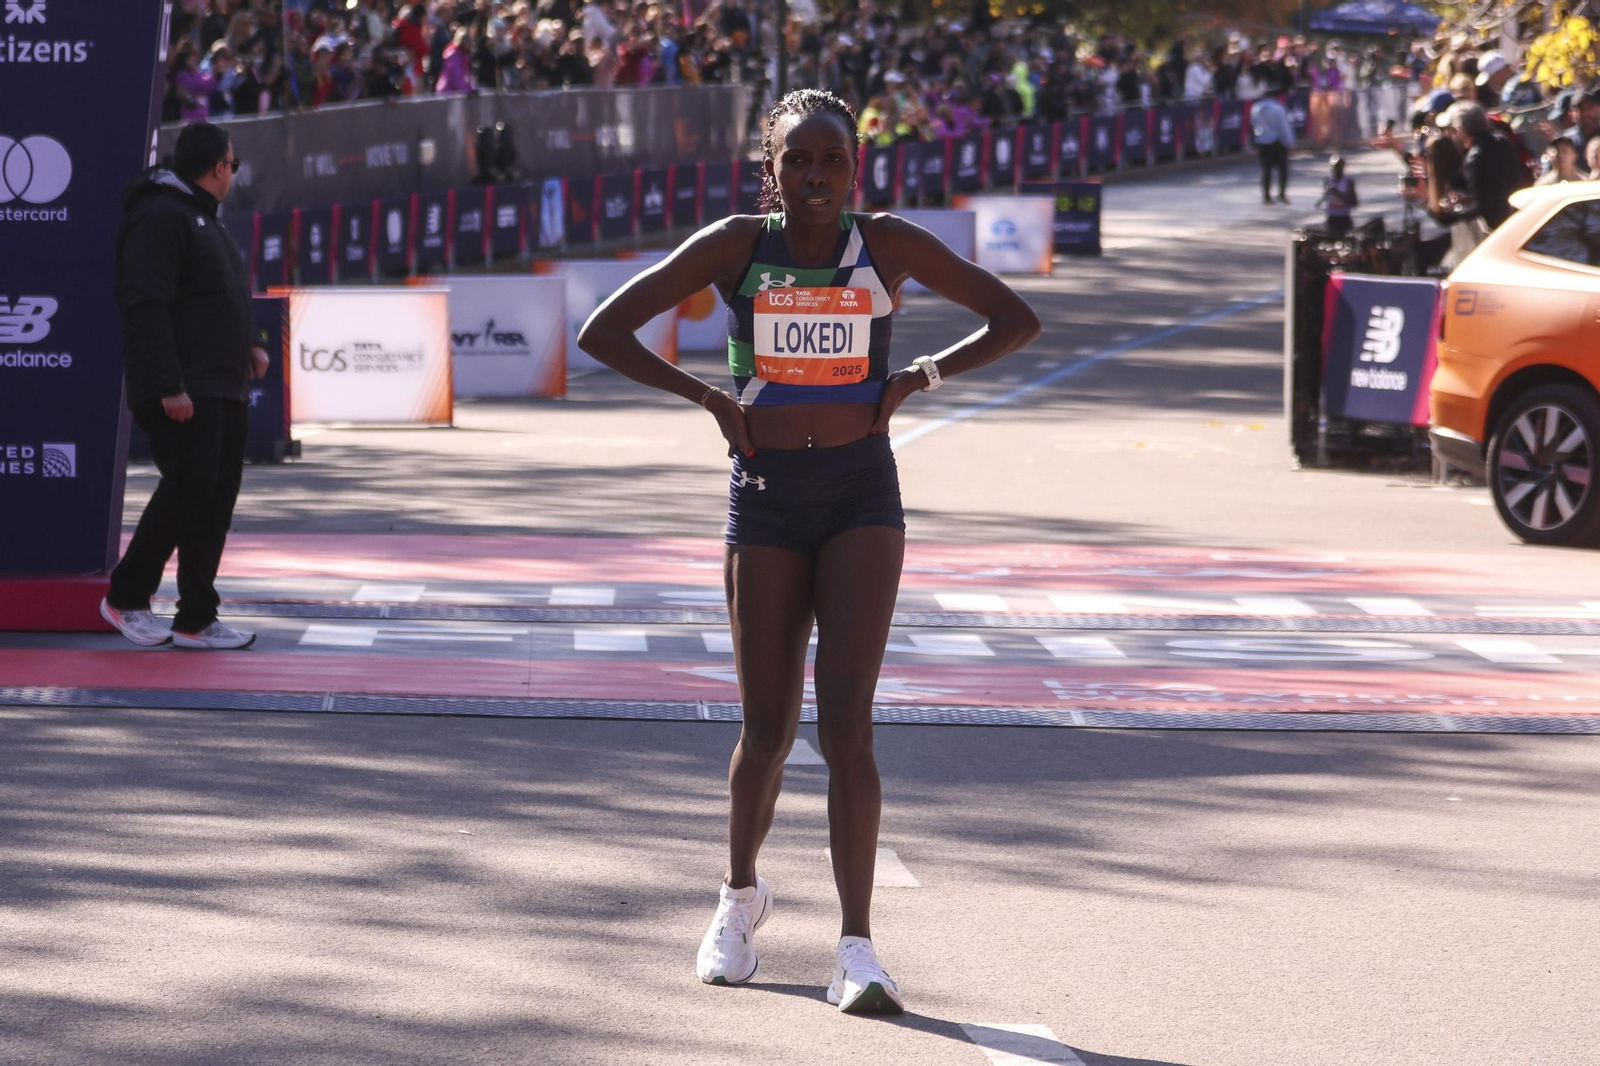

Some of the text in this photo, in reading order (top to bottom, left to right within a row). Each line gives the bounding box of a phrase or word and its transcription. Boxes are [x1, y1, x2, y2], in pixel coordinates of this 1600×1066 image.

[769, 291, 794, 306] tcs
[773, 321, 854, 354] LOKEDI
[299, 342, 348, 372] tcs
[832, 364, 862, 377] 2025
